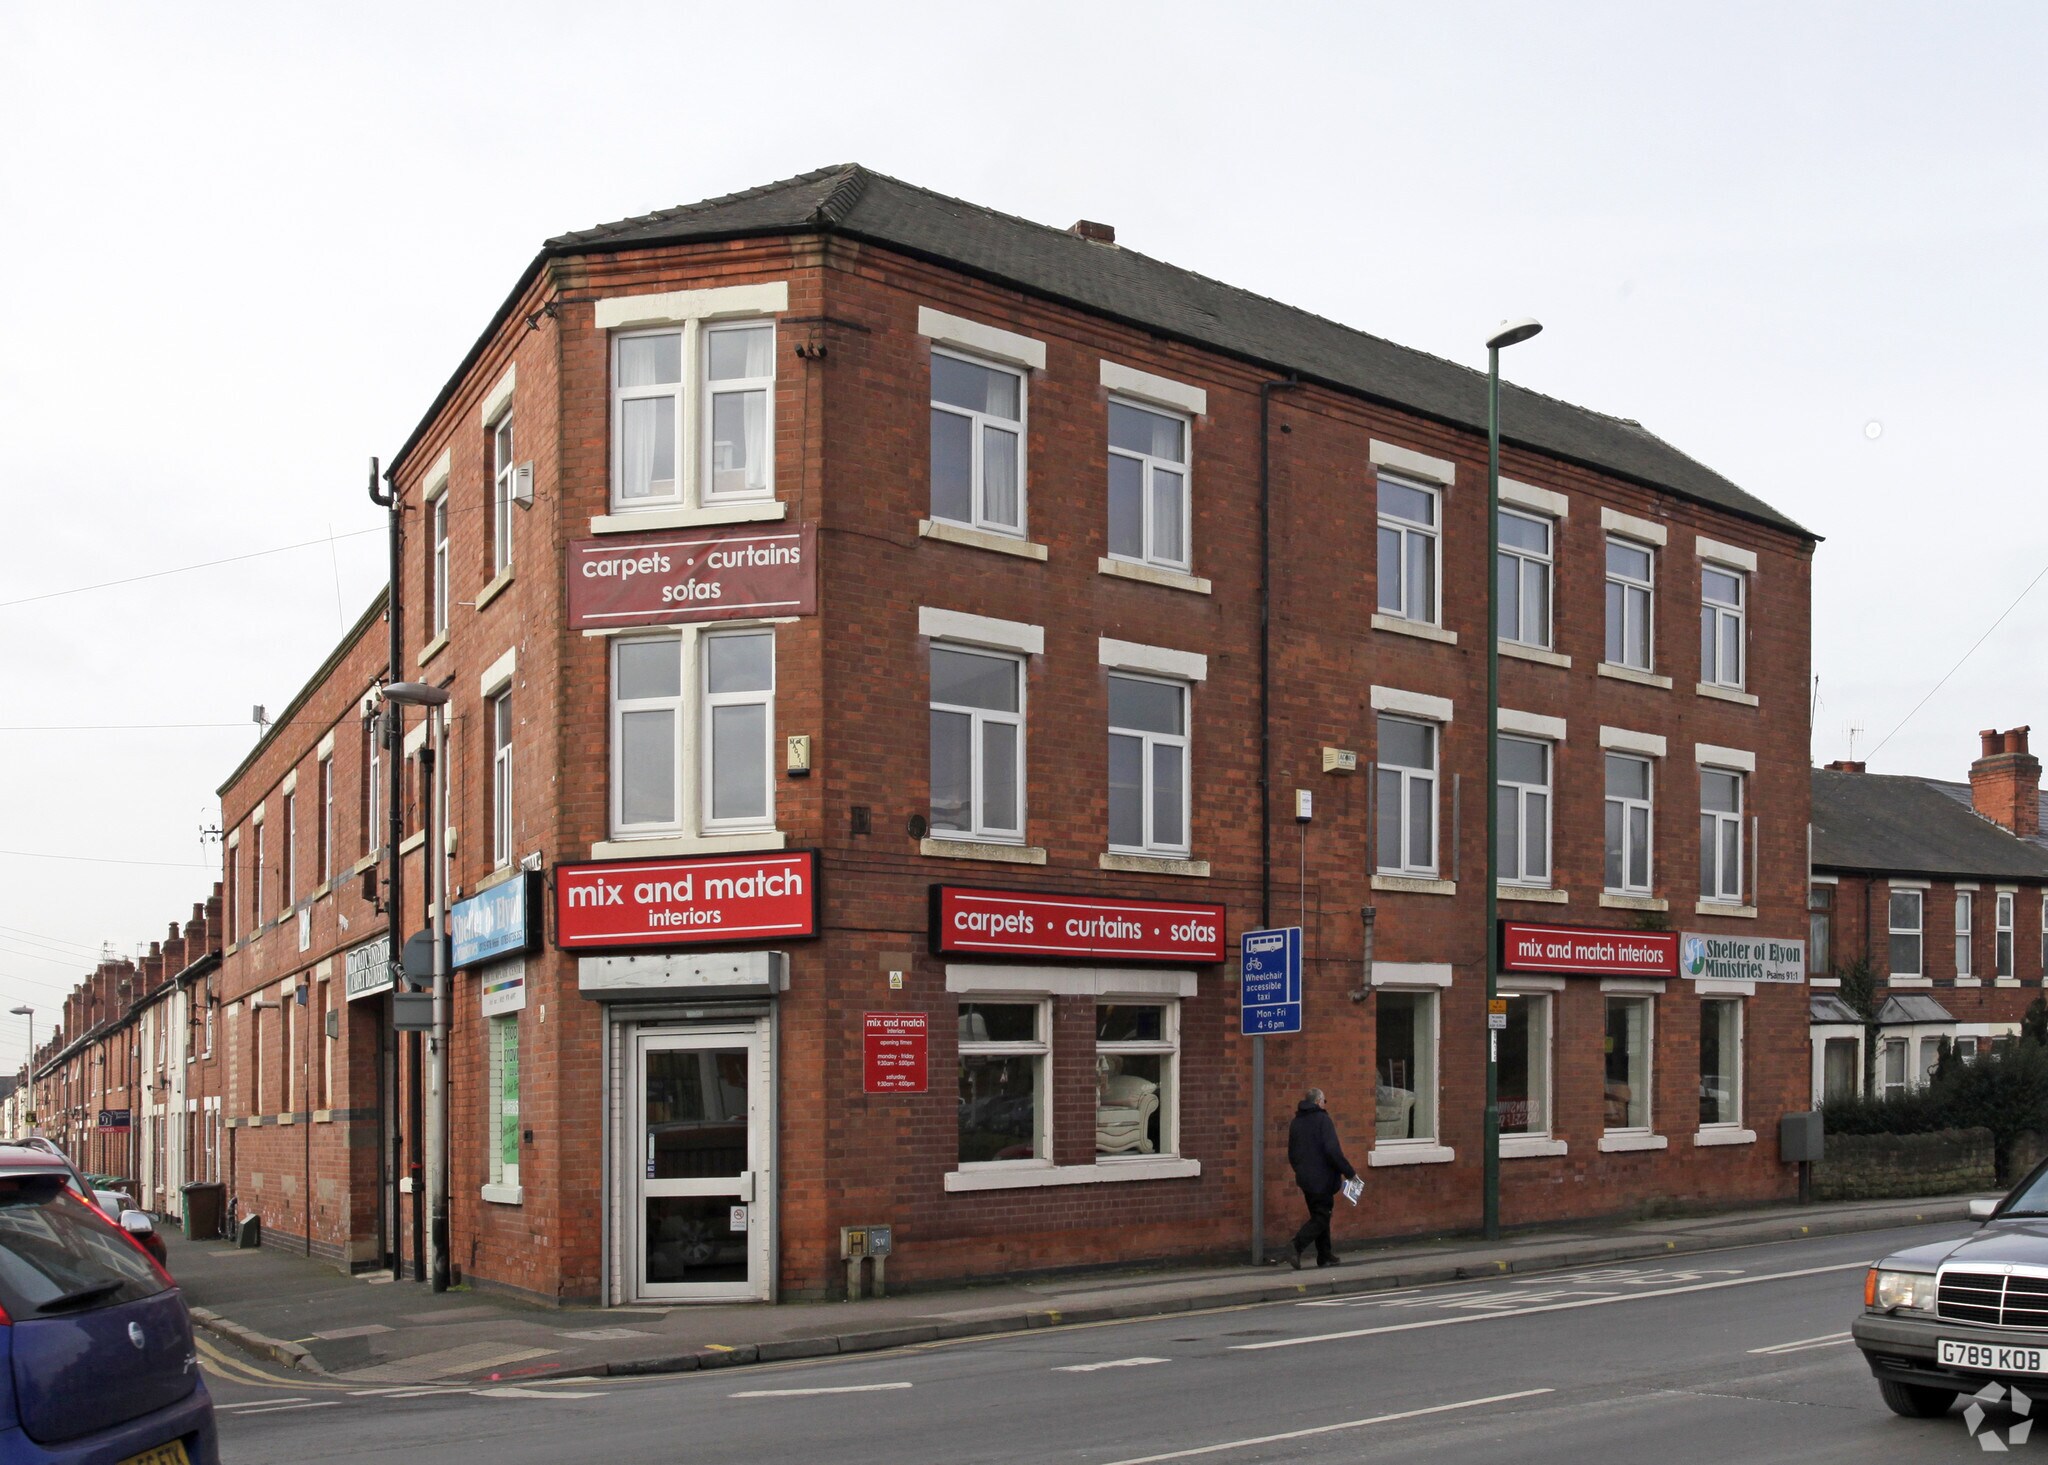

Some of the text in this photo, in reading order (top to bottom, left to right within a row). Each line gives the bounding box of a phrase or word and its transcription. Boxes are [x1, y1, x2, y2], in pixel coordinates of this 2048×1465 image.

[582, 543, 801, 580] carpets curtains
[662, 578, 721, 602] sofas
[568, 868, 802, 908] mix and match
[648, 907, 722, 927] interiors
[954, 910, 1216, 943] carpets curtains sofas
[1518, 939, 1664, 964] mix and match interiors
[1706, 939, 1801, 964] Shelter of Elyon
[1246, 972, 1282, 981] Wheelchair
[1705, 959, 1763, 978] Ministries
[1766, 970, 1786, 981] Psalms
[1247, 982, 1281, 991] accessible
[875, 1238, 885, 1246] SV
[1943, 1343, 2041, 1371] G789 KOB
